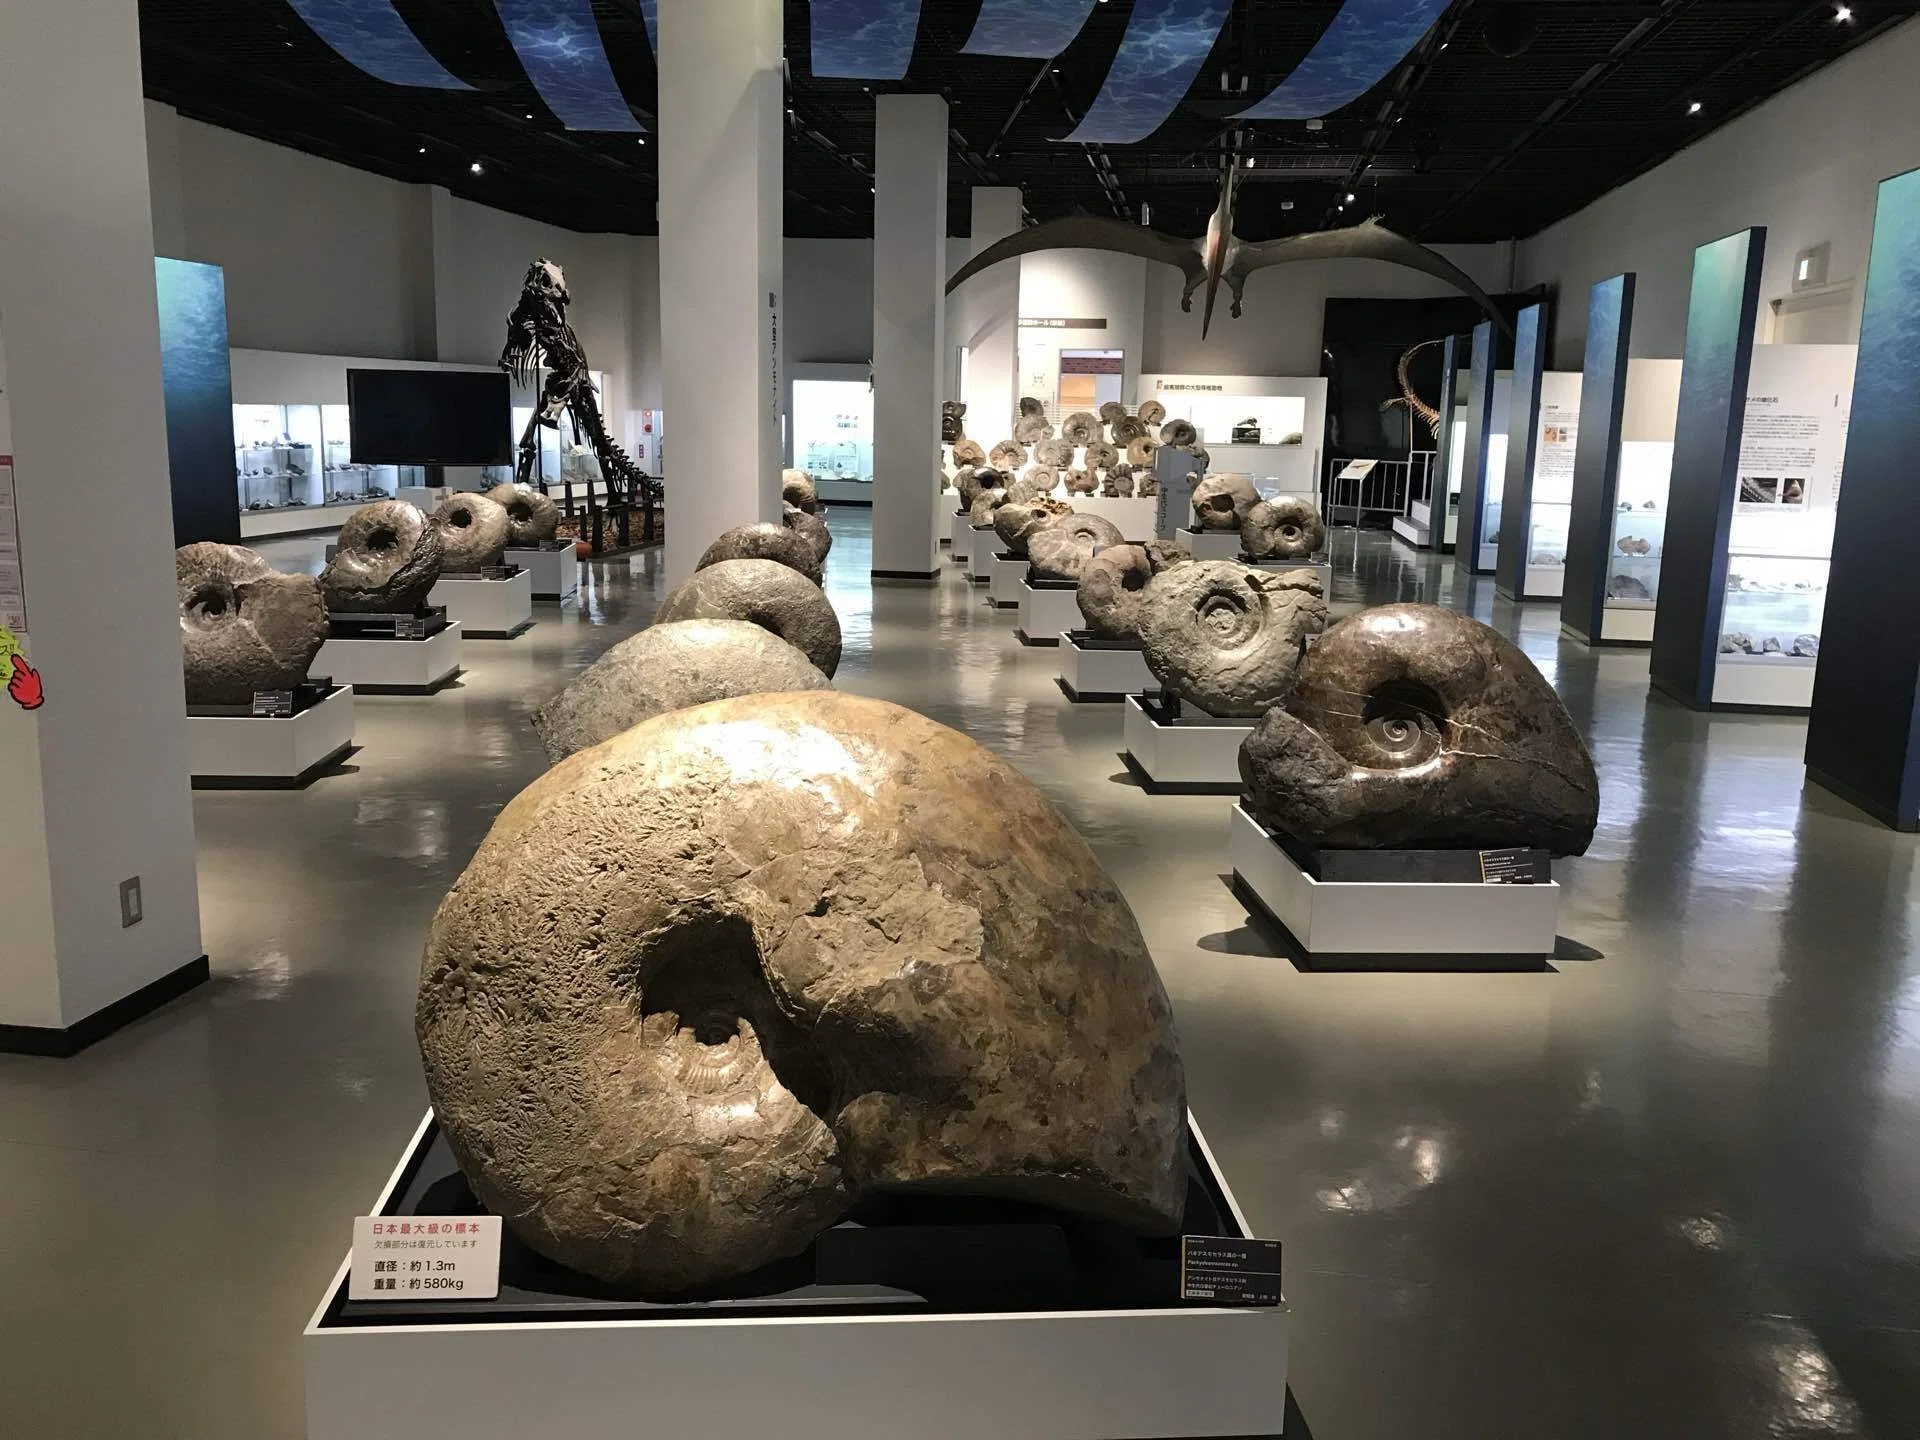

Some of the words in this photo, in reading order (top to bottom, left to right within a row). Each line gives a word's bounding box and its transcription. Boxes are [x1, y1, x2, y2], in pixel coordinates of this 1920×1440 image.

[373, 1223, 480, 1235] 日本最大級の標本
[374, 1240, 478, 1249] 欠損部分は復元しています
